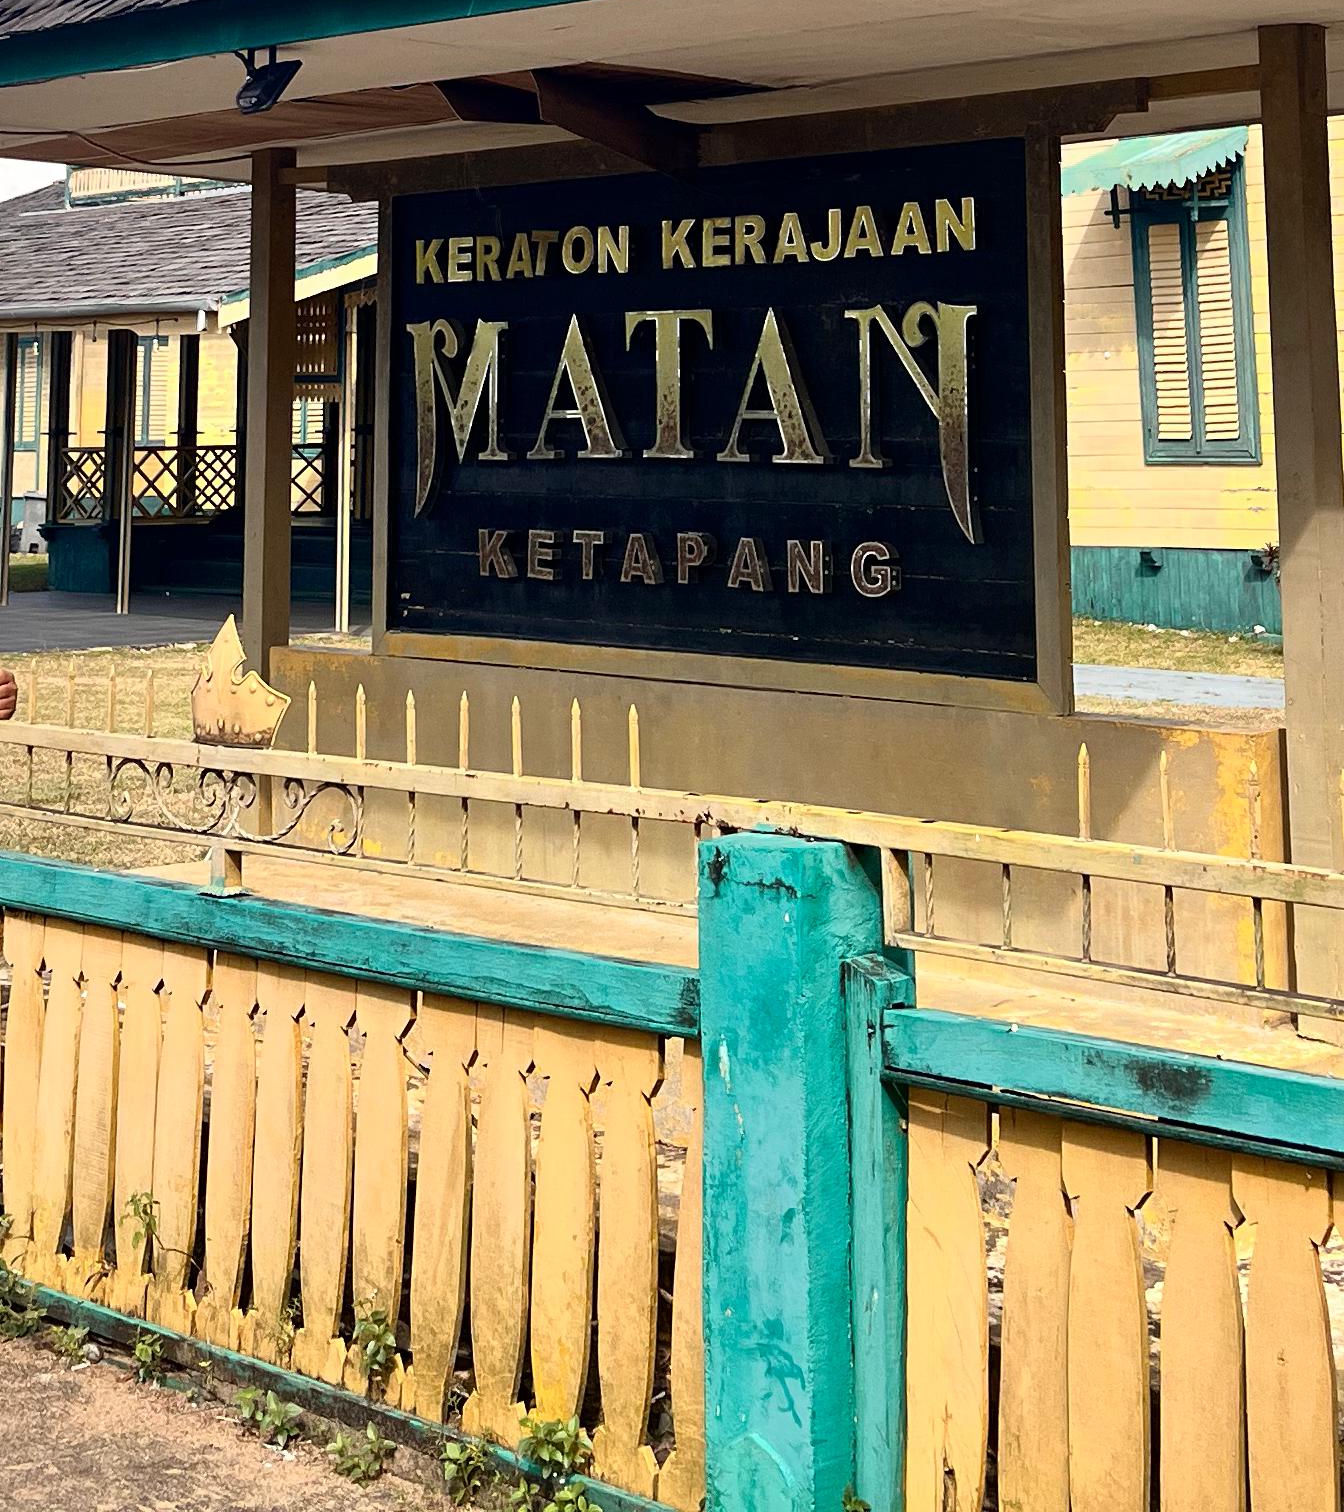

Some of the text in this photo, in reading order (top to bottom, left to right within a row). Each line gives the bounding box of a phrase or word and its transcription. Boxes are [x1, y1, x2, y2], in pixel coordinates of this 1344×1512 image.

[414, 196, 976, 285] KERATON KERAJAAN
[405, 300, 983, 545] MATAN
[476, 527, 900, 598] KETAPANG
